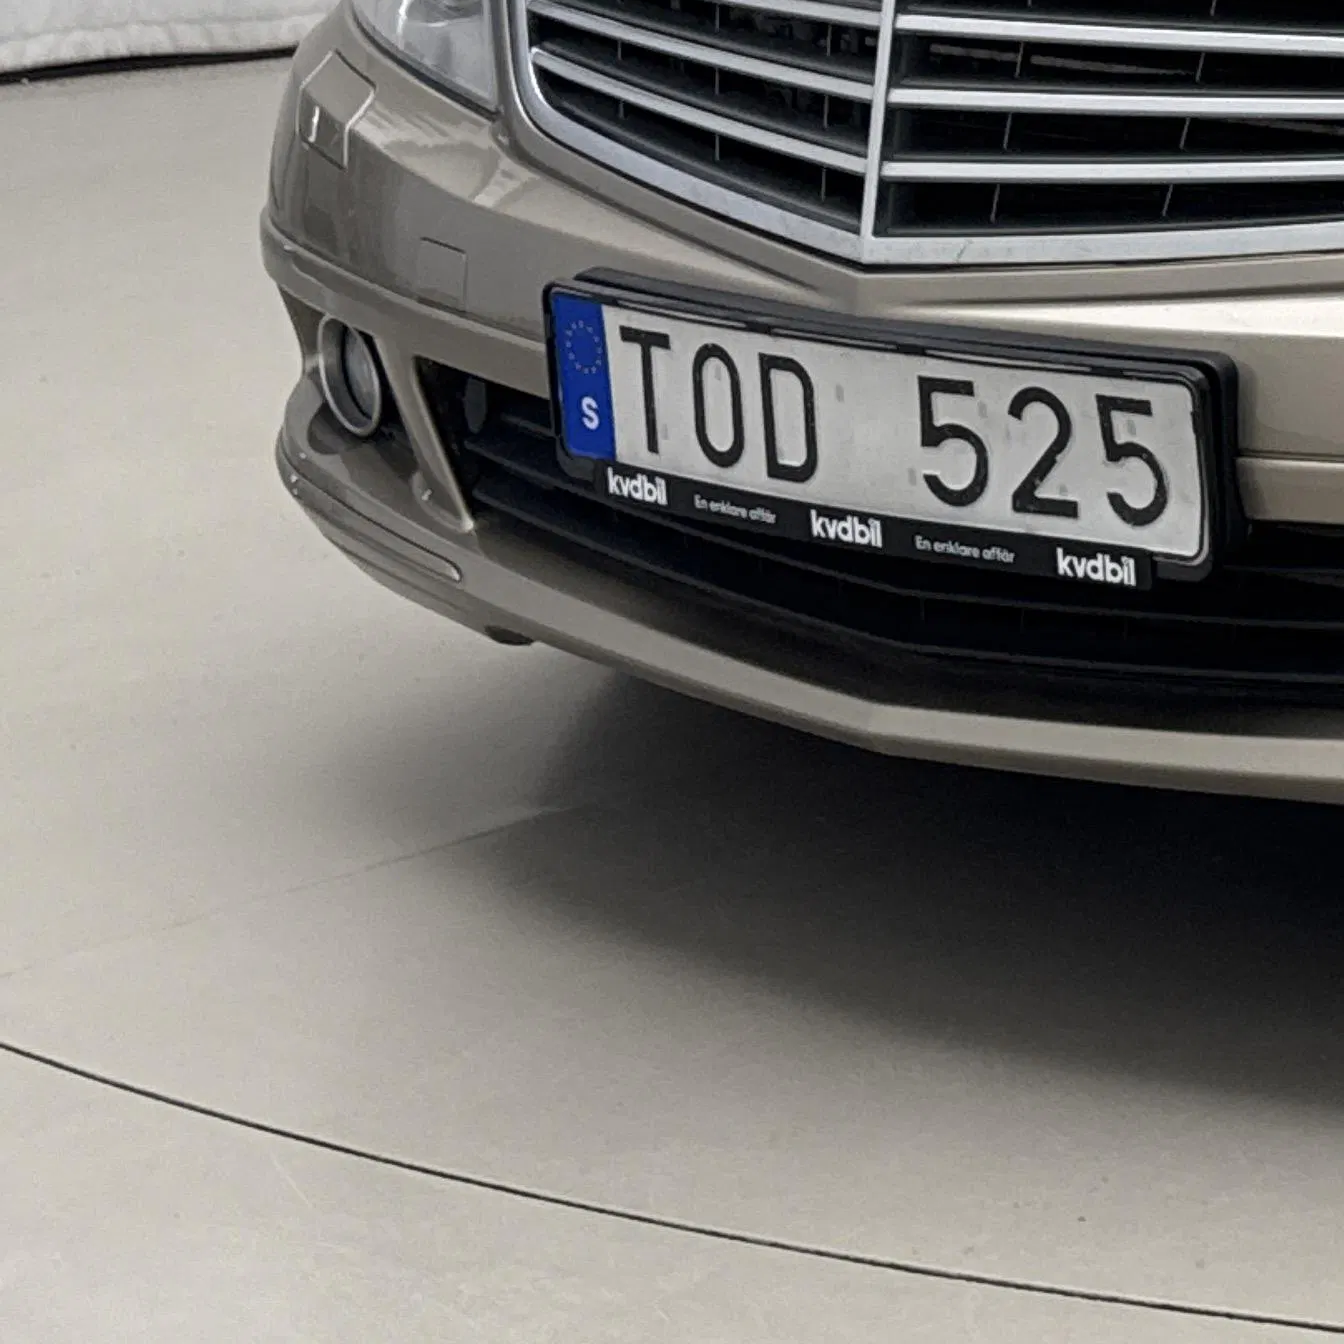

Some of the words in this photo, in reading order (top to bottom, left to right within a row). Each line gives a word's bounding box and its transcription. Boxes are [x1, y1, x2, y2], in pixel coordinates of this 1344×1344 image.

[581, 396, 599, 430] S
[619, 325, 818, 484] TOD
[917, 375, 1168, 527] 525
[607, 466, 668, 506] kvdbil
[810, 508, 883, 549] kvdbil
[914, 534, 932, 552] En
[1056, 546, 1137, 587] kvdbil
